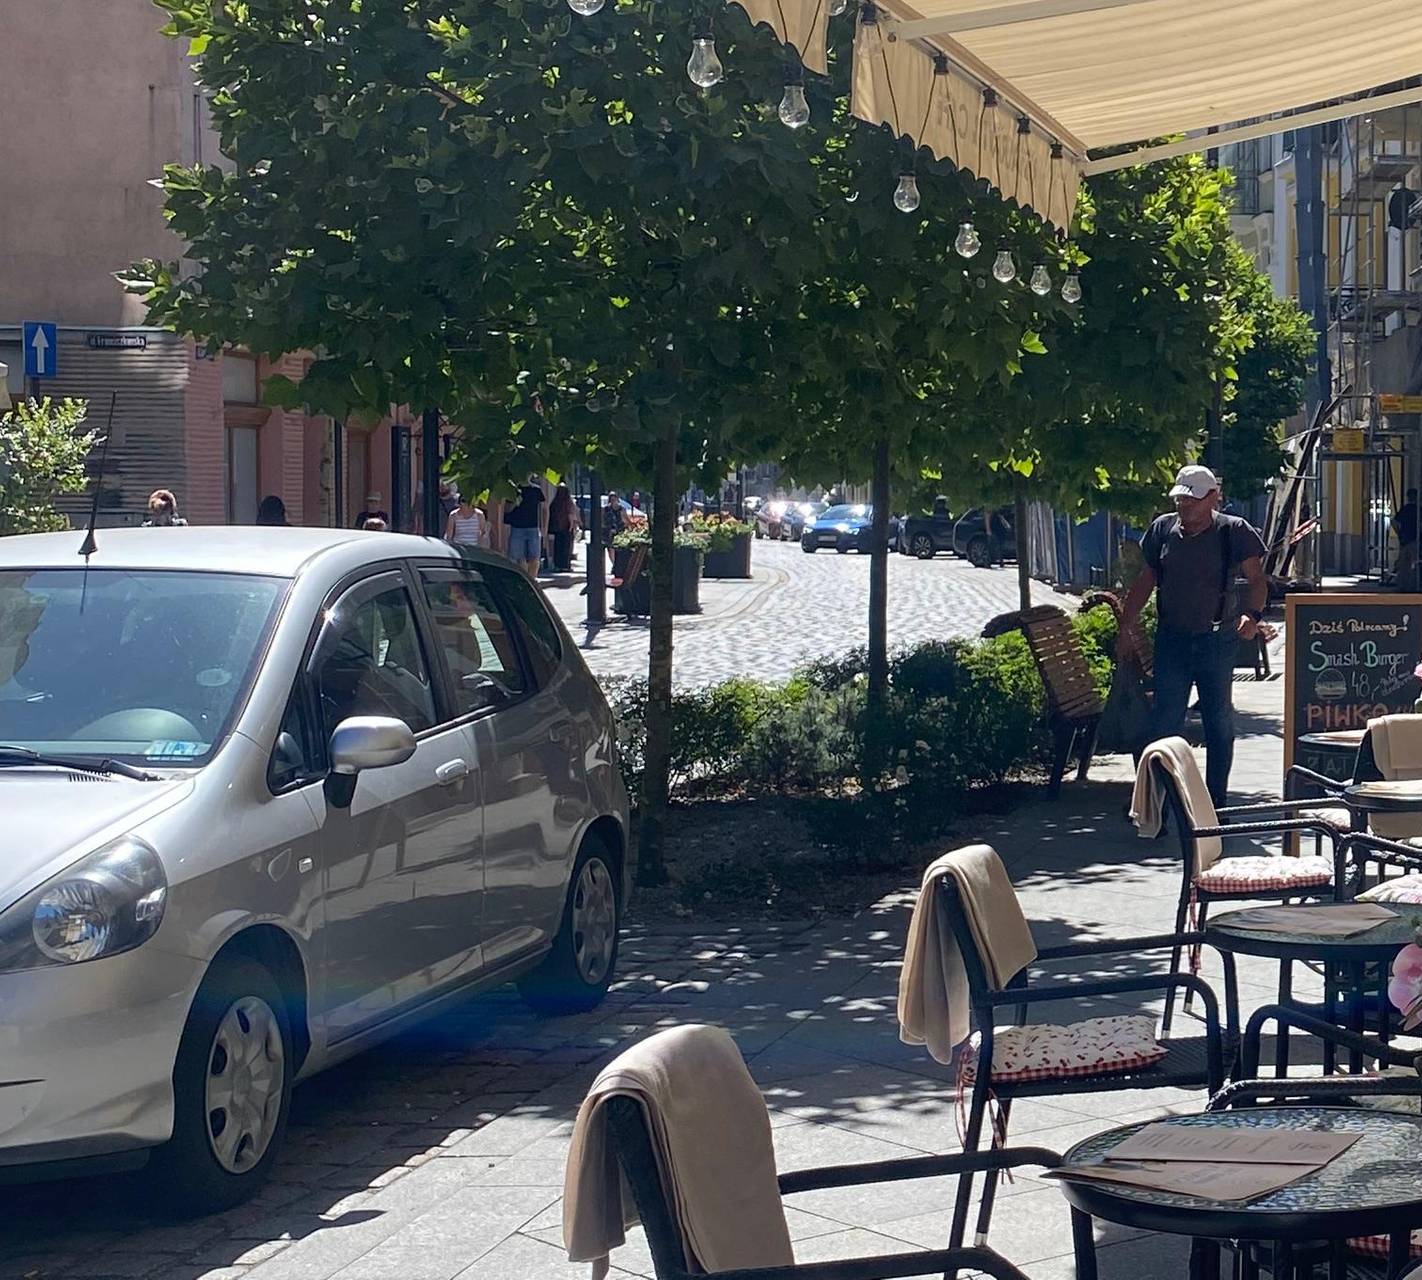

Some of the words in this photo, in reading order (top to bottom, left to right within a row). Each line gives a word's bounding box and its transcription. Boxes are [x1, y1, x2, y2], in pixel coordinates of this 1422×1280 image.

[1309, 620, 1345, 635] Dziś
[1308, 641, 1360, 672] Smash
[1359, 640, 1410, 676] Burger
